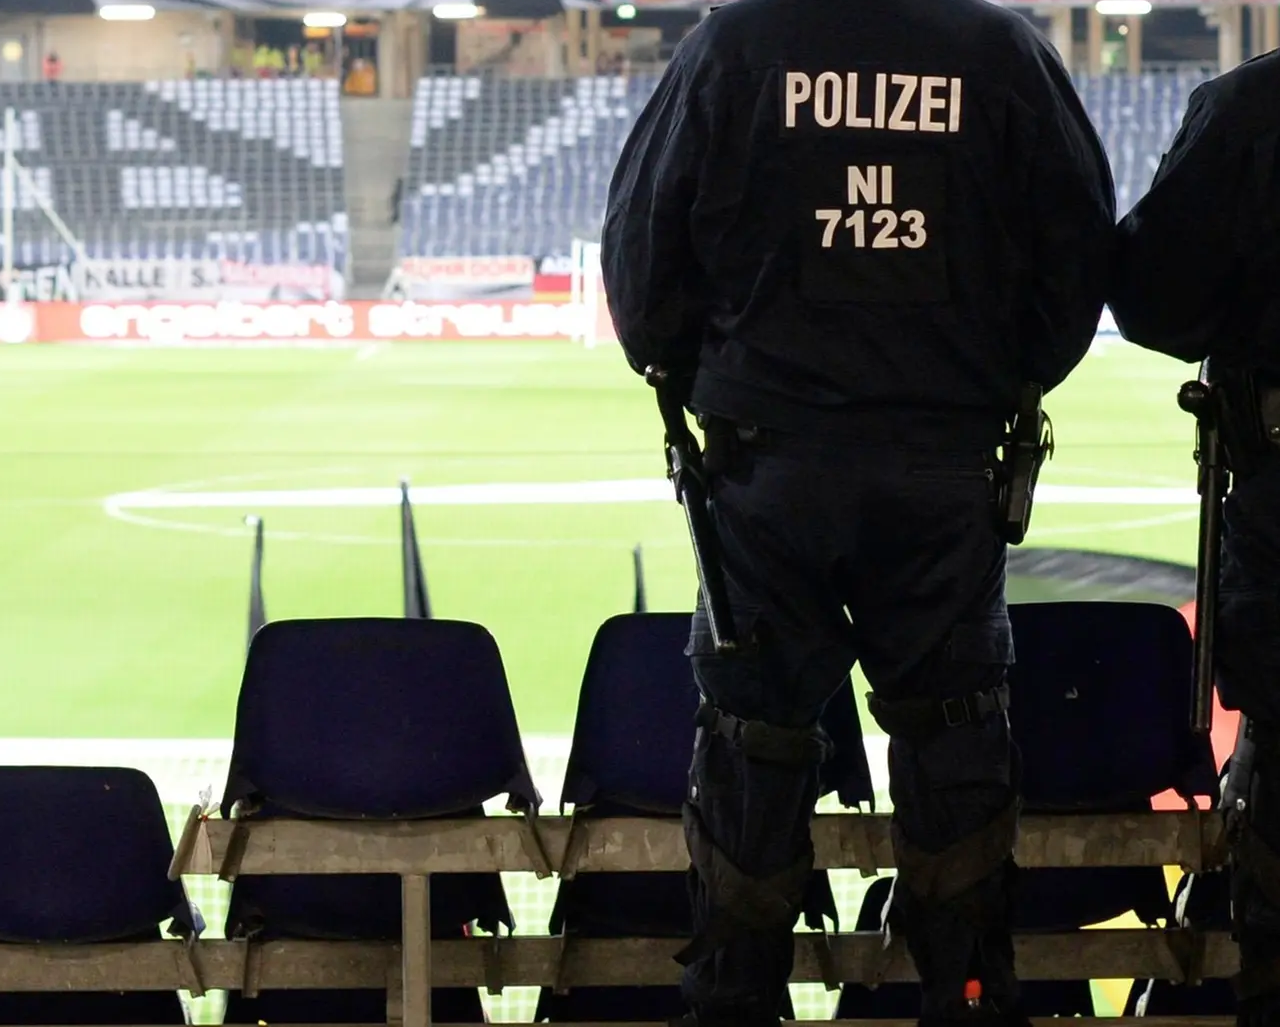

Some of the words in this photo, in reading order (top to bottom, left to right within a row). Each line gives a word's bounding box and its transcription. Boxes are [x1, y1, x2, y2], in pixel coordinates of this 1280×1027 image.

[785, 70, 962, 132] POLIZEI
[847, 165, 893, 205] NI
[815, 209, 927, 249] 7123
